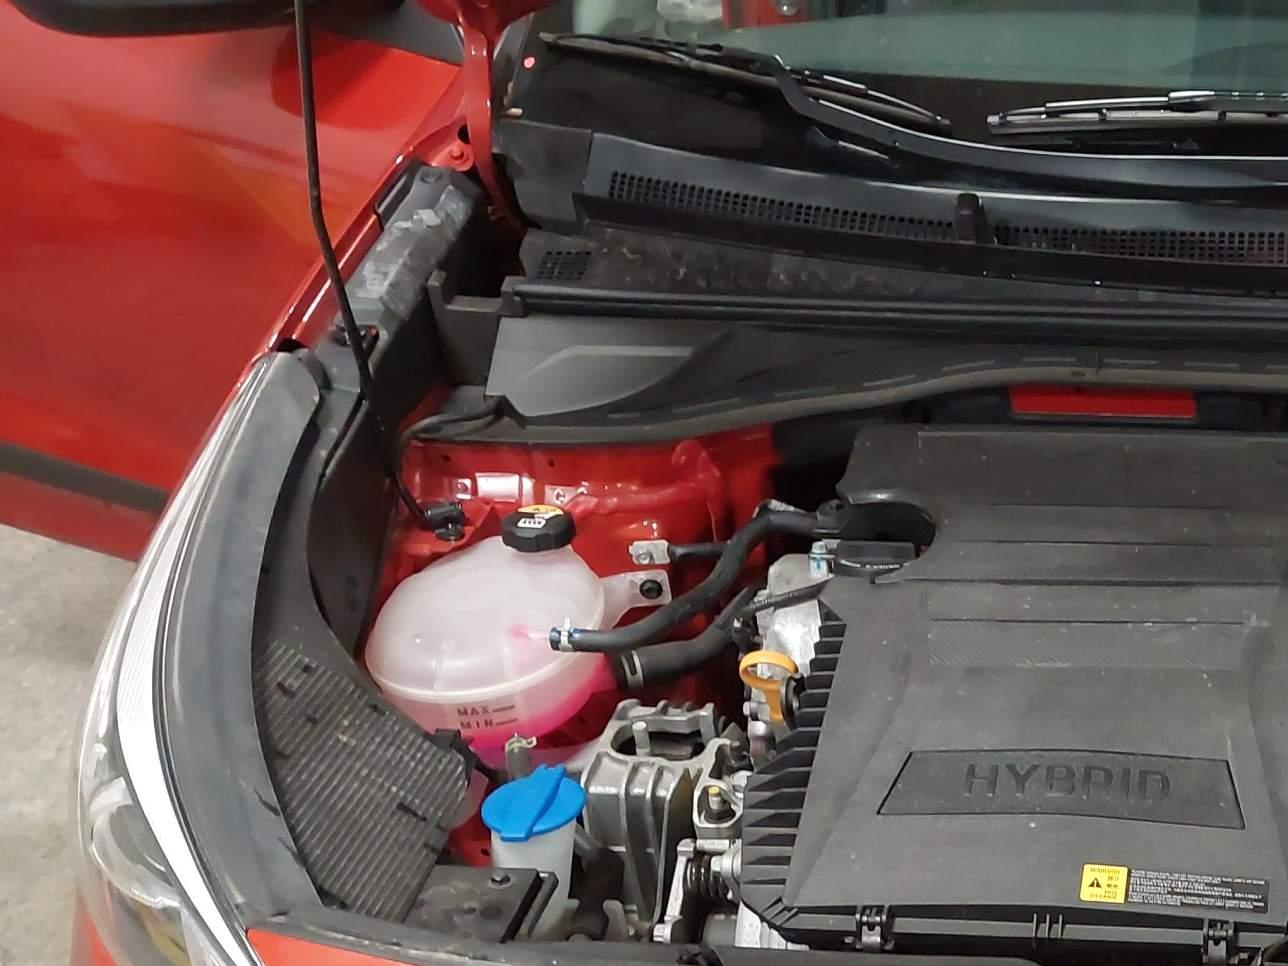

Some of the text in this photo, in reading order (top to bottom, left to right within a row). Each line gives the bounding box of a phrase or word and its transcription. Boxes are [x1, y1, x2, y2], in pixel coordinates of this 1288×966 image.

[457, 705, 490, 716] MAX
[460, 719, 493, 729] MIN
[963, 763, 1171, 803] HYBRID
